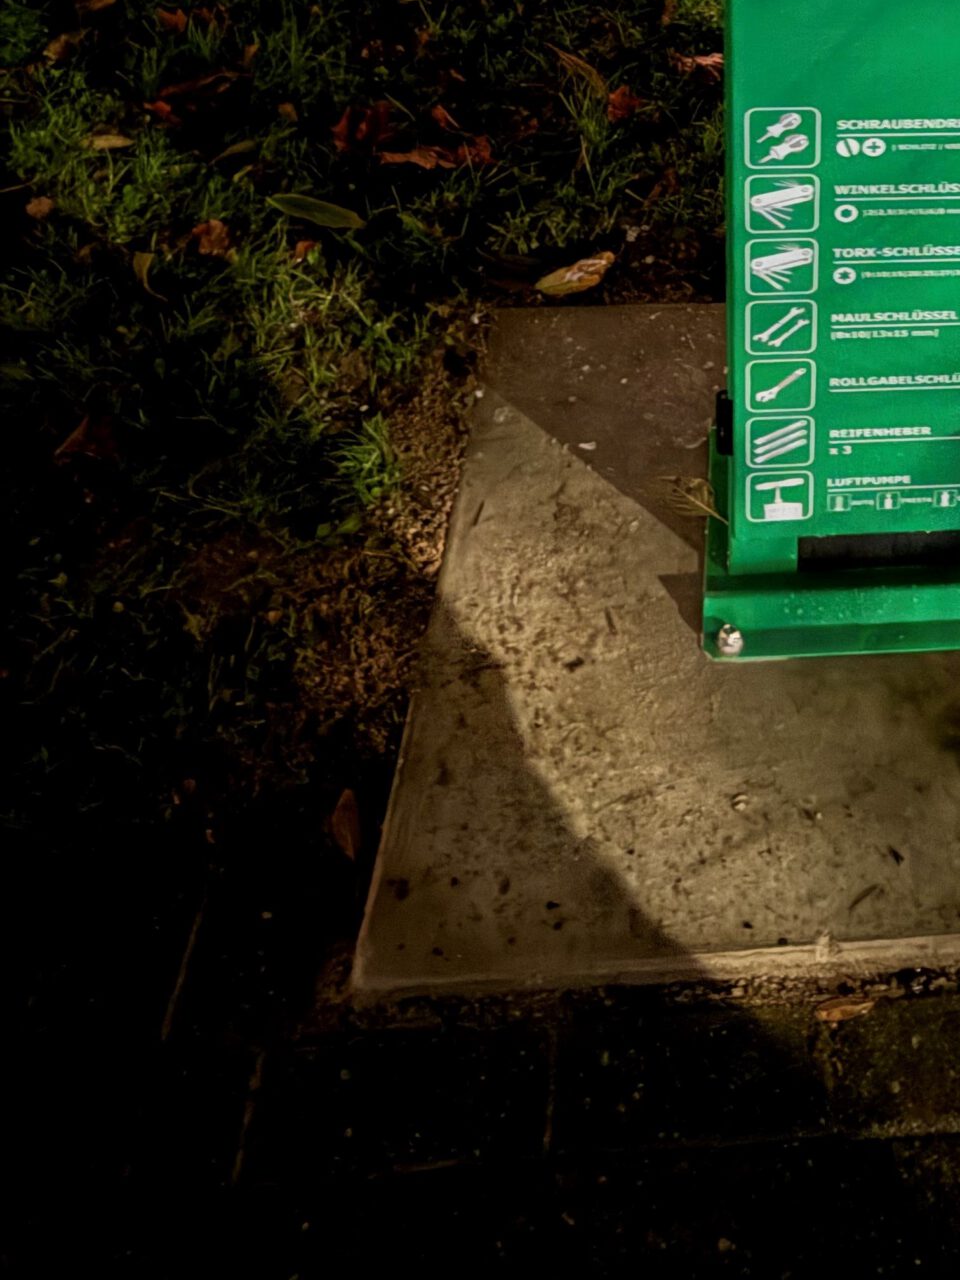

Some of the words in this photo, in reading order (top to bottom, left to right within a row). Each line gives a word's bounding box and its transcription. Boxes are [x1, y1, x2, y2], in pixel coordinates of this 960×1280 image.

[830, 310, 959, 323] MAULSCHLÜSSEL
[829, 426, 932, 439] REIFENHEBER
[842, 445, 852, 455] 3
[826, 475, 911, 487] LUFTPUMPE
